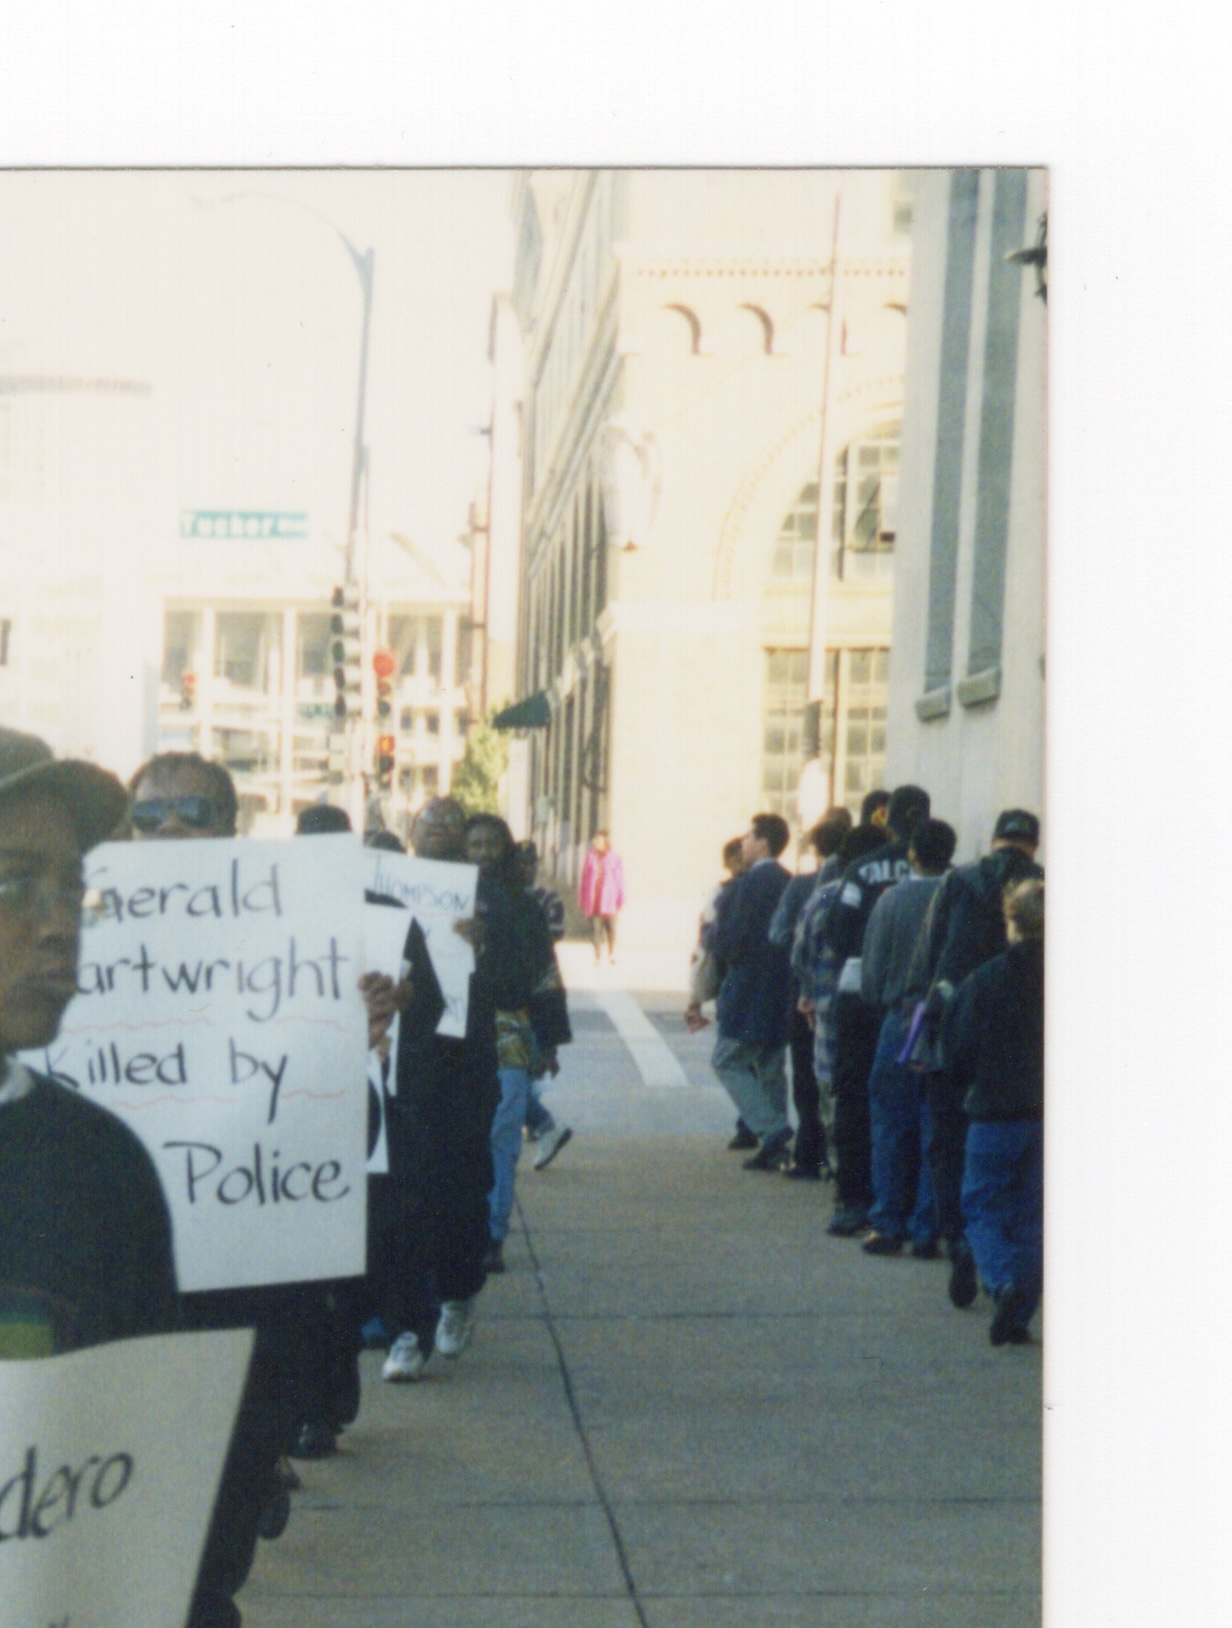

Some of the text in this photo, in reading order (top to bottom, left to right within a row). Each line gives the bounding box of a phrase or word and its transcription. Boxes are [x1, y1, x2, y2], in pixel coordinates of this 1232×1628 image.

[76, 934, 350, 1022] artwright
[229, 1036, 288, 1124] by
[162, 1141, 351, 1206] Police
